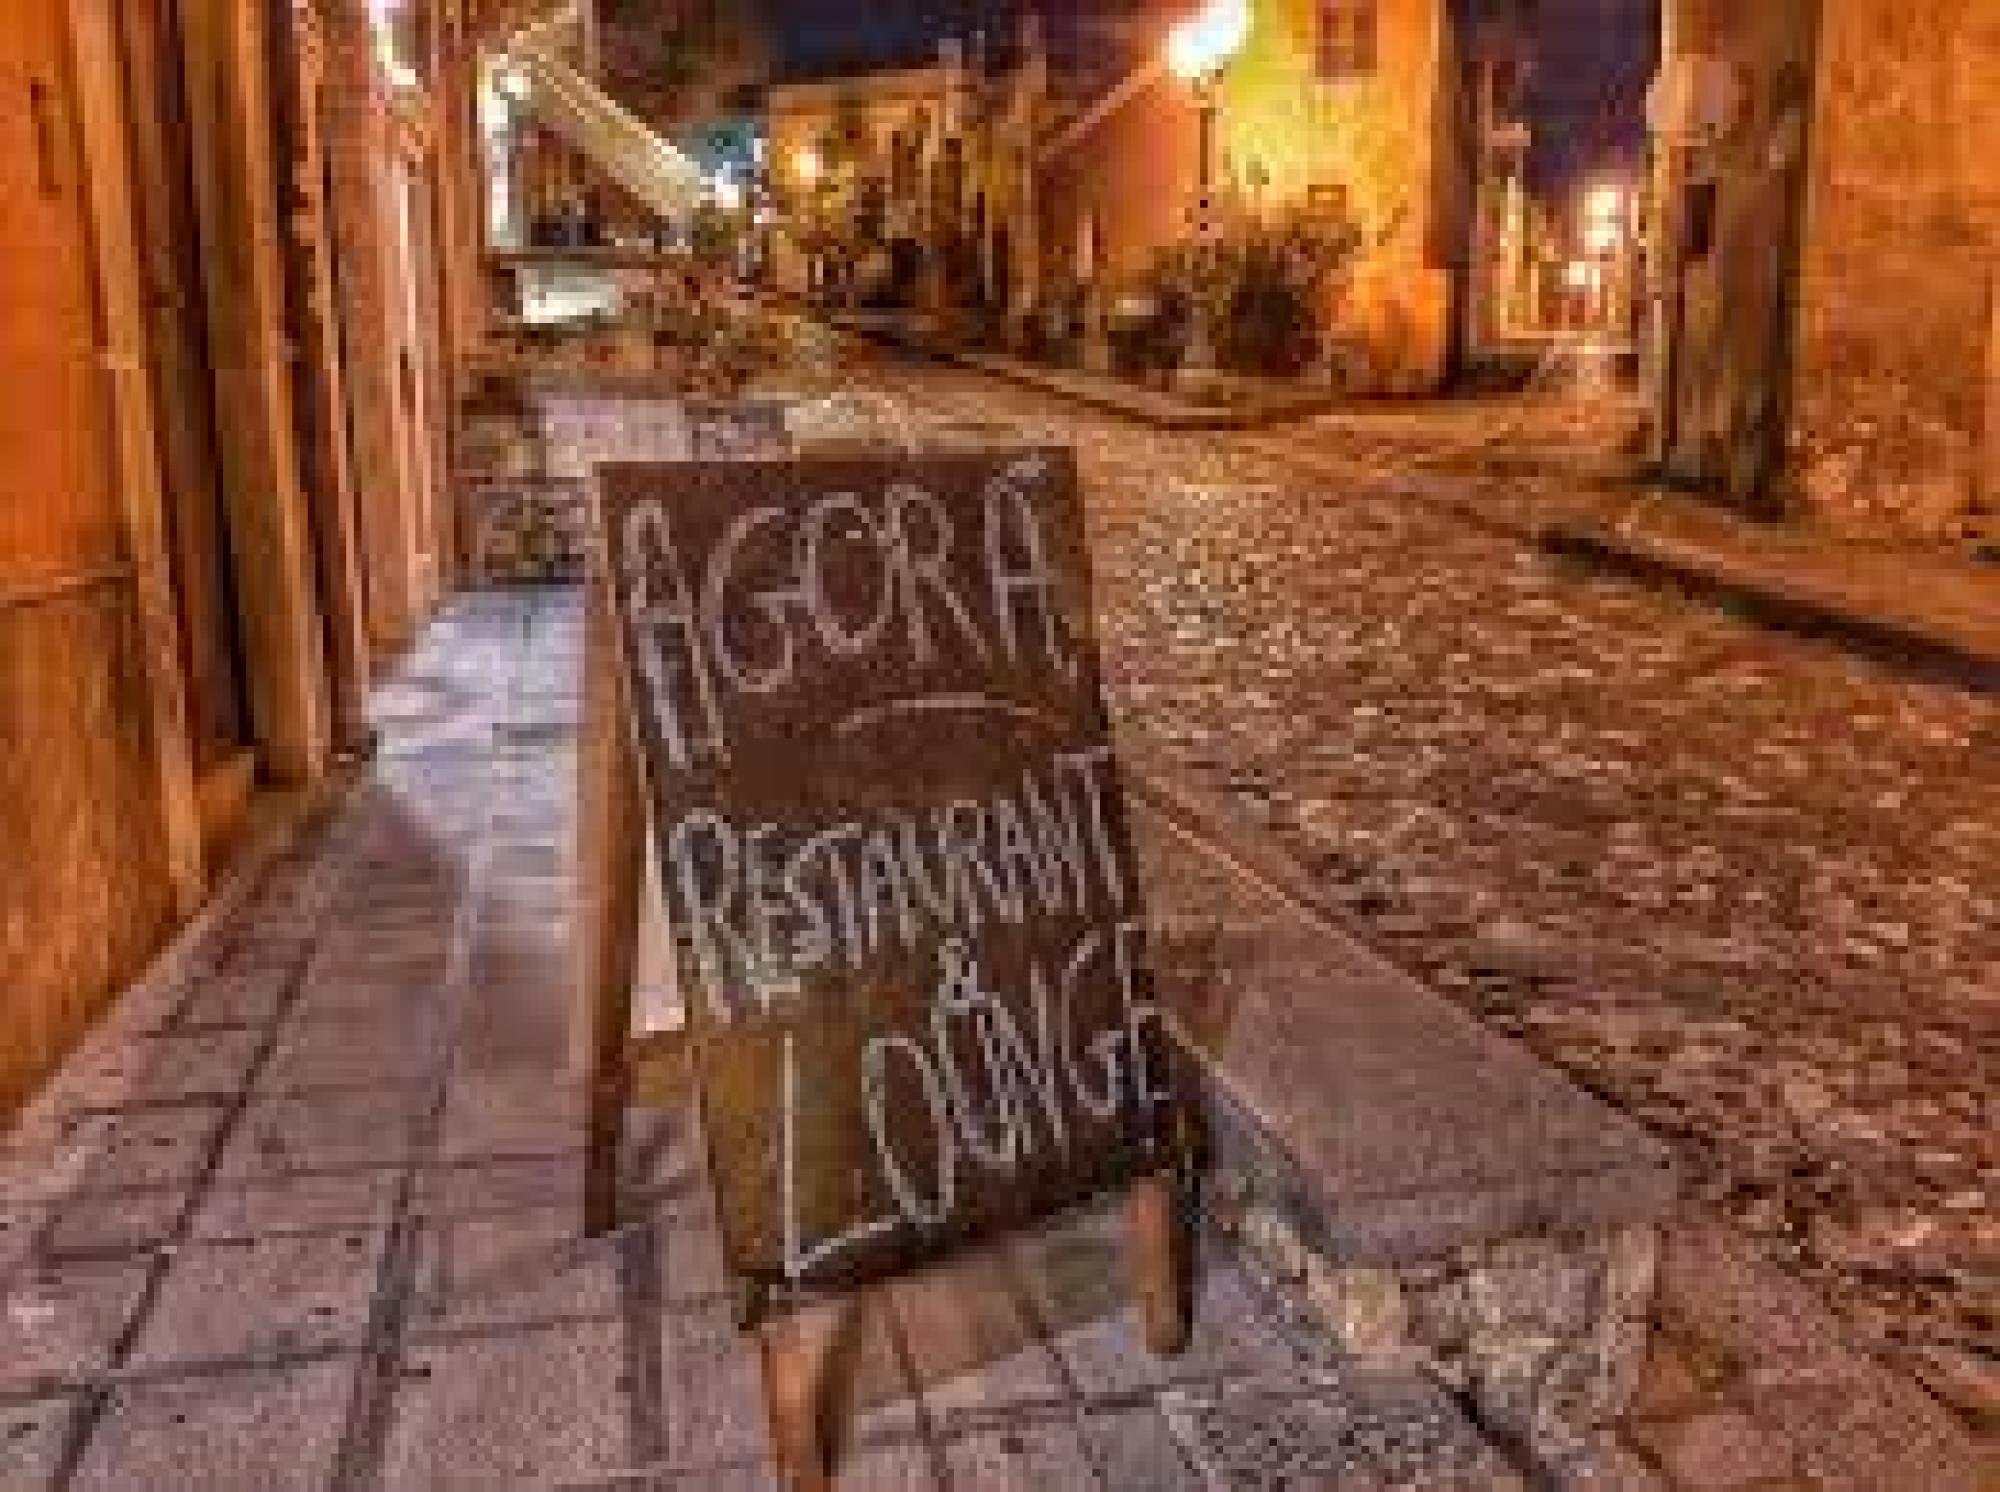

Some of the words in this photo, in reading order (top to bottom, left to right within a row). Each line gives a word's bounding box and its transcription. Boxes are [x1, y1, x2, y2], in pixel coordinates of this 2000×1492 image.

[668, 746, 1124, 1024] RESTAURANT
[936, 937, 986, 1009] &
[783, 922, 1170, 1278] LOUNGE
